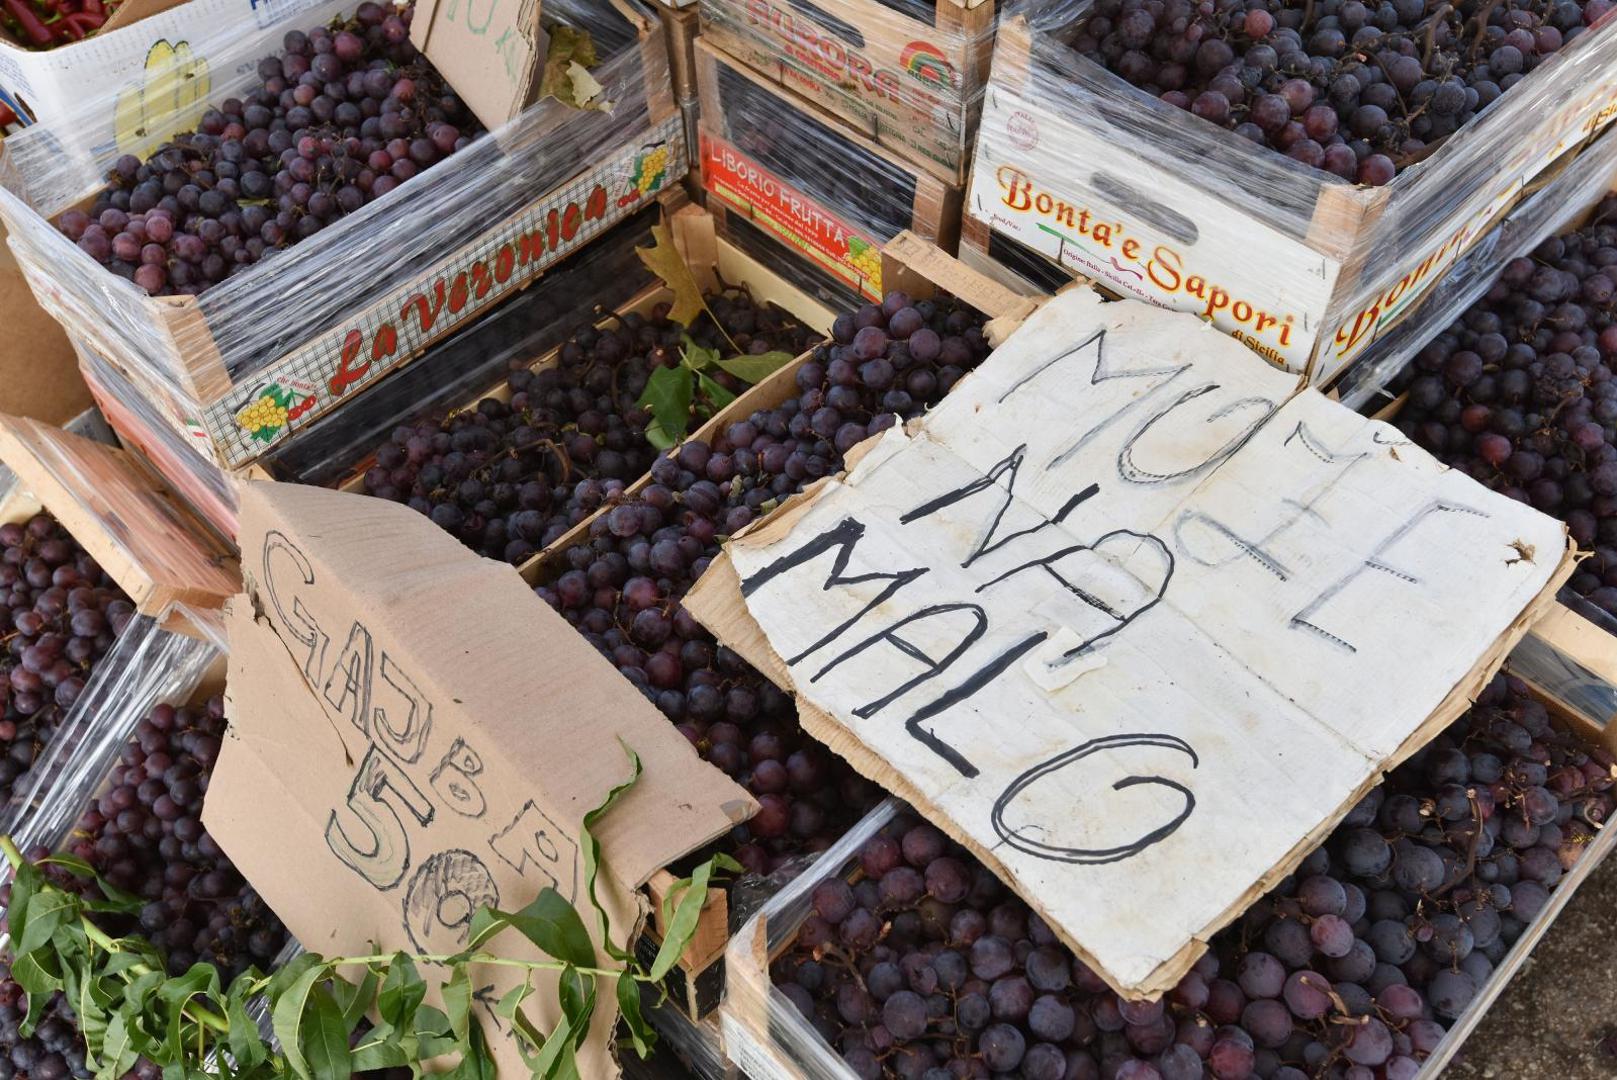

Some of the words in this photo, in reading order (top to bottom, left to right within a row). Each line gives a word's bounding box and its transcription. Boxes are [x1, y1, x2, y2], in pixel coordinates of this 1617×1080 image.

[710, 140, 777, 198] LIBORIO
[779, 188, 846, 249] FRUTTA
[329, 323, 398, 396] La
[401, 184, 608, 333] Veronica
[1147, 246, 1296, 347] Sapori
[1245, 335, 1286, 366] Sicilia
[901, 443, 1175, 666] NA
[741, 517, 1199, 866] MALO
